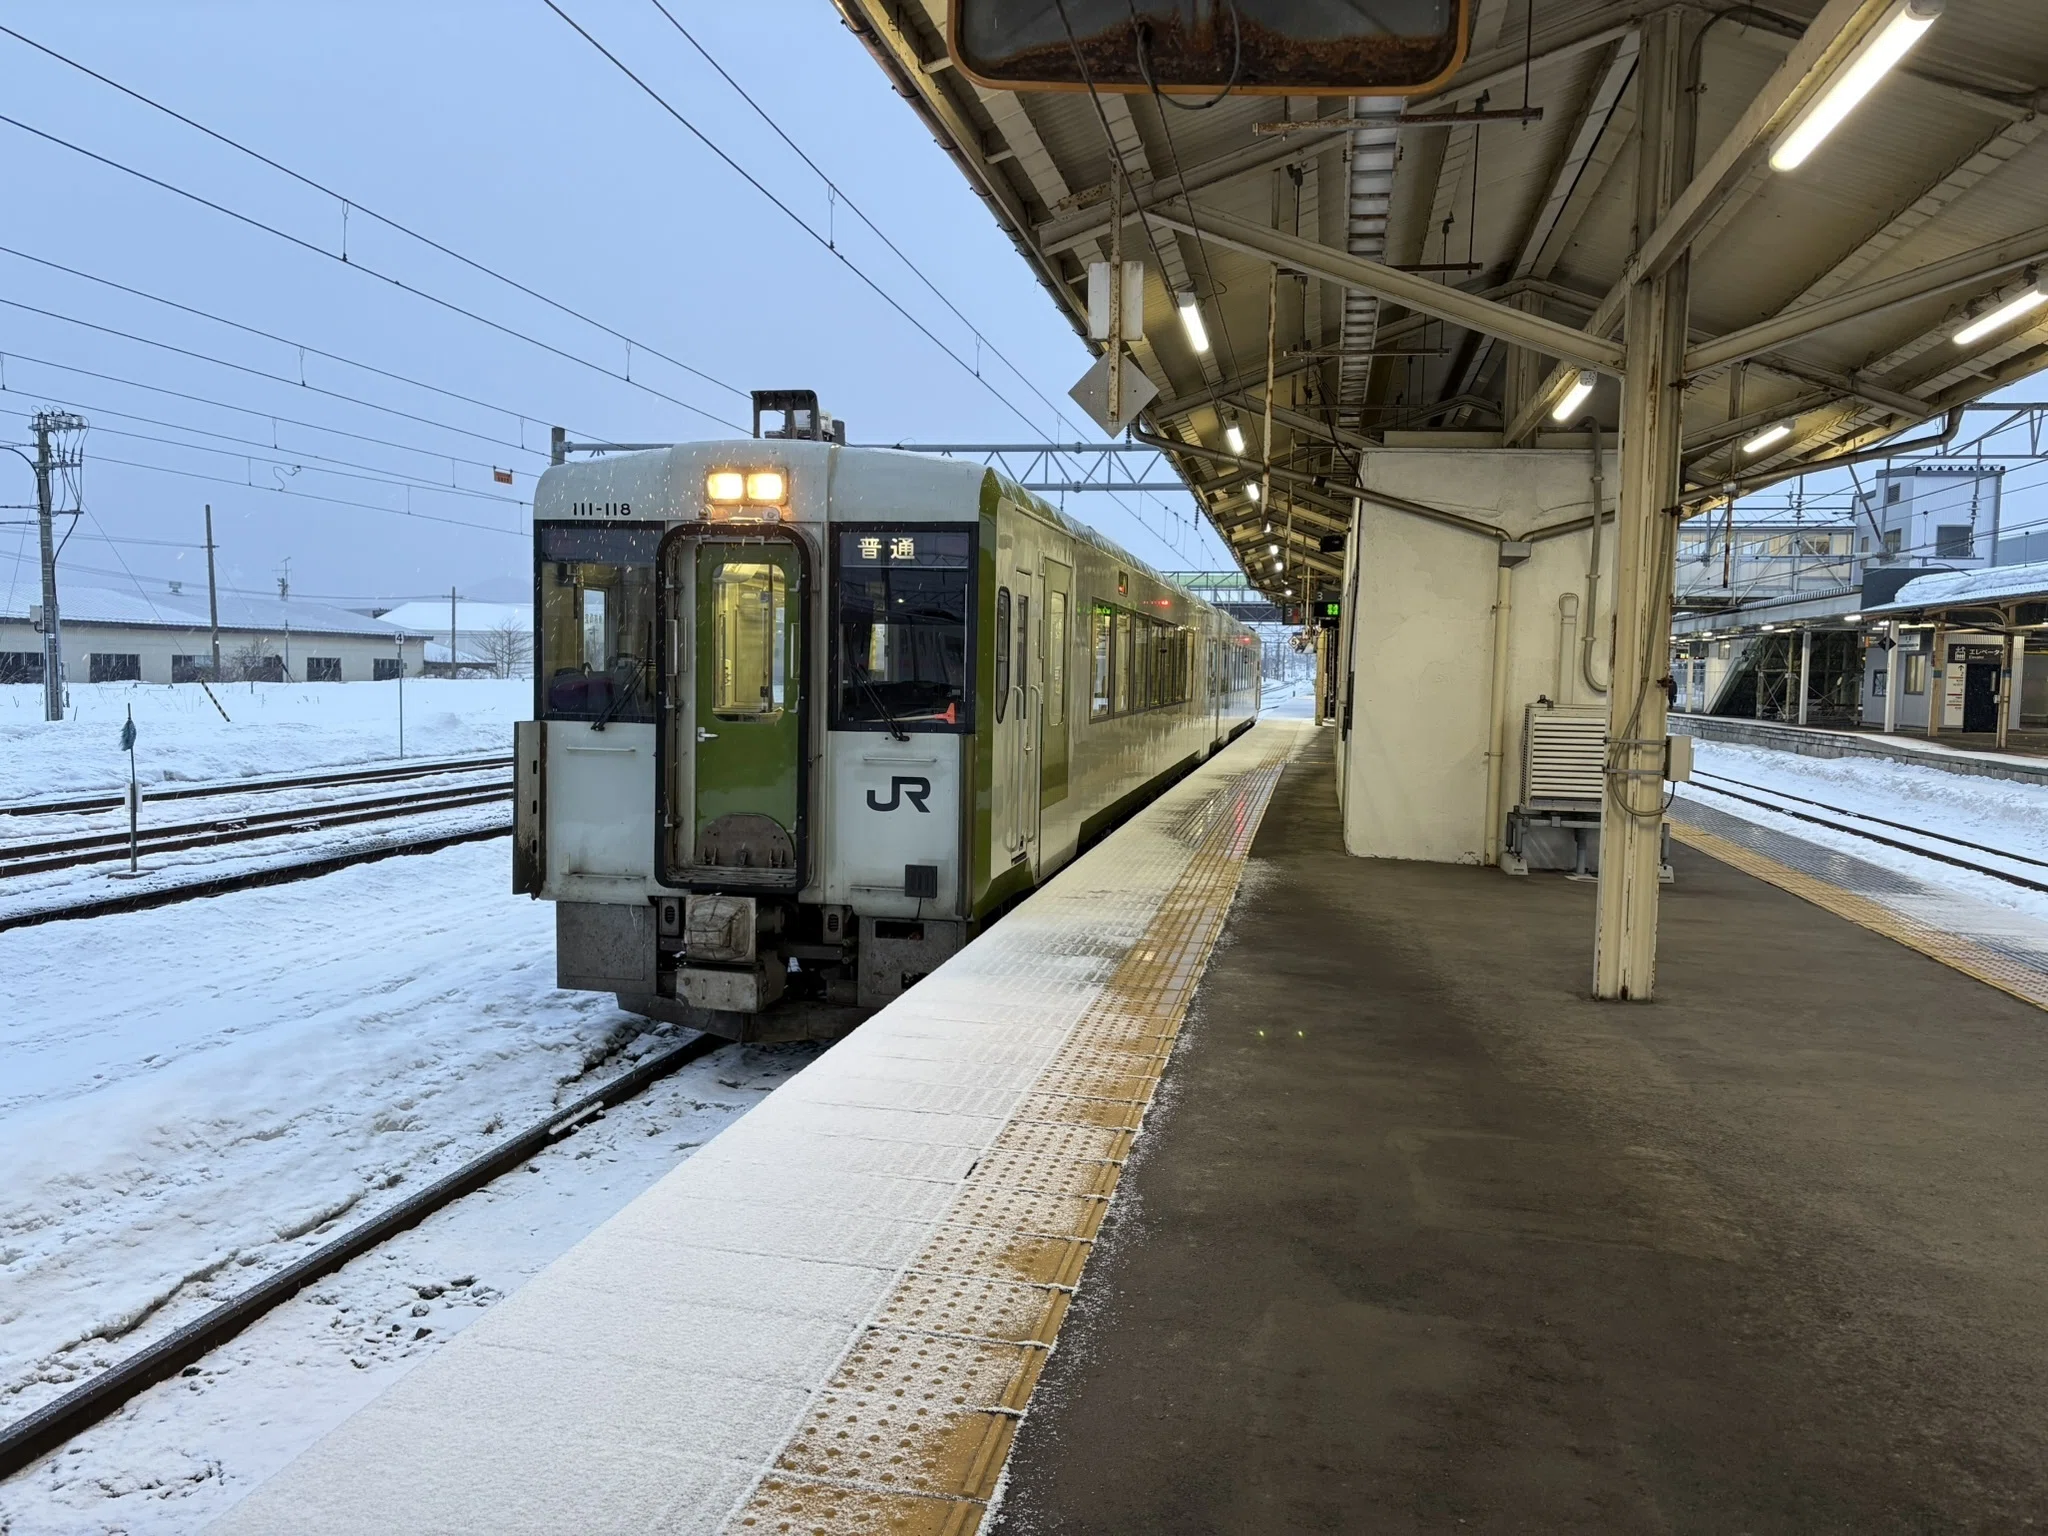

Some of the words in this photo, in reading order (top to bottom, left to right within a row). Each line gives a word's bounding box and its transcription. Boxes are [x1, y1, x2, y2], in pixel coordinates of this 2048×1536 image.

[573, 502, 631, 516] 111-118
[857, 536, 915, 559] 普通
[1317, 592, 1323, 600] 3
[867, 776, 931, 813] JR
